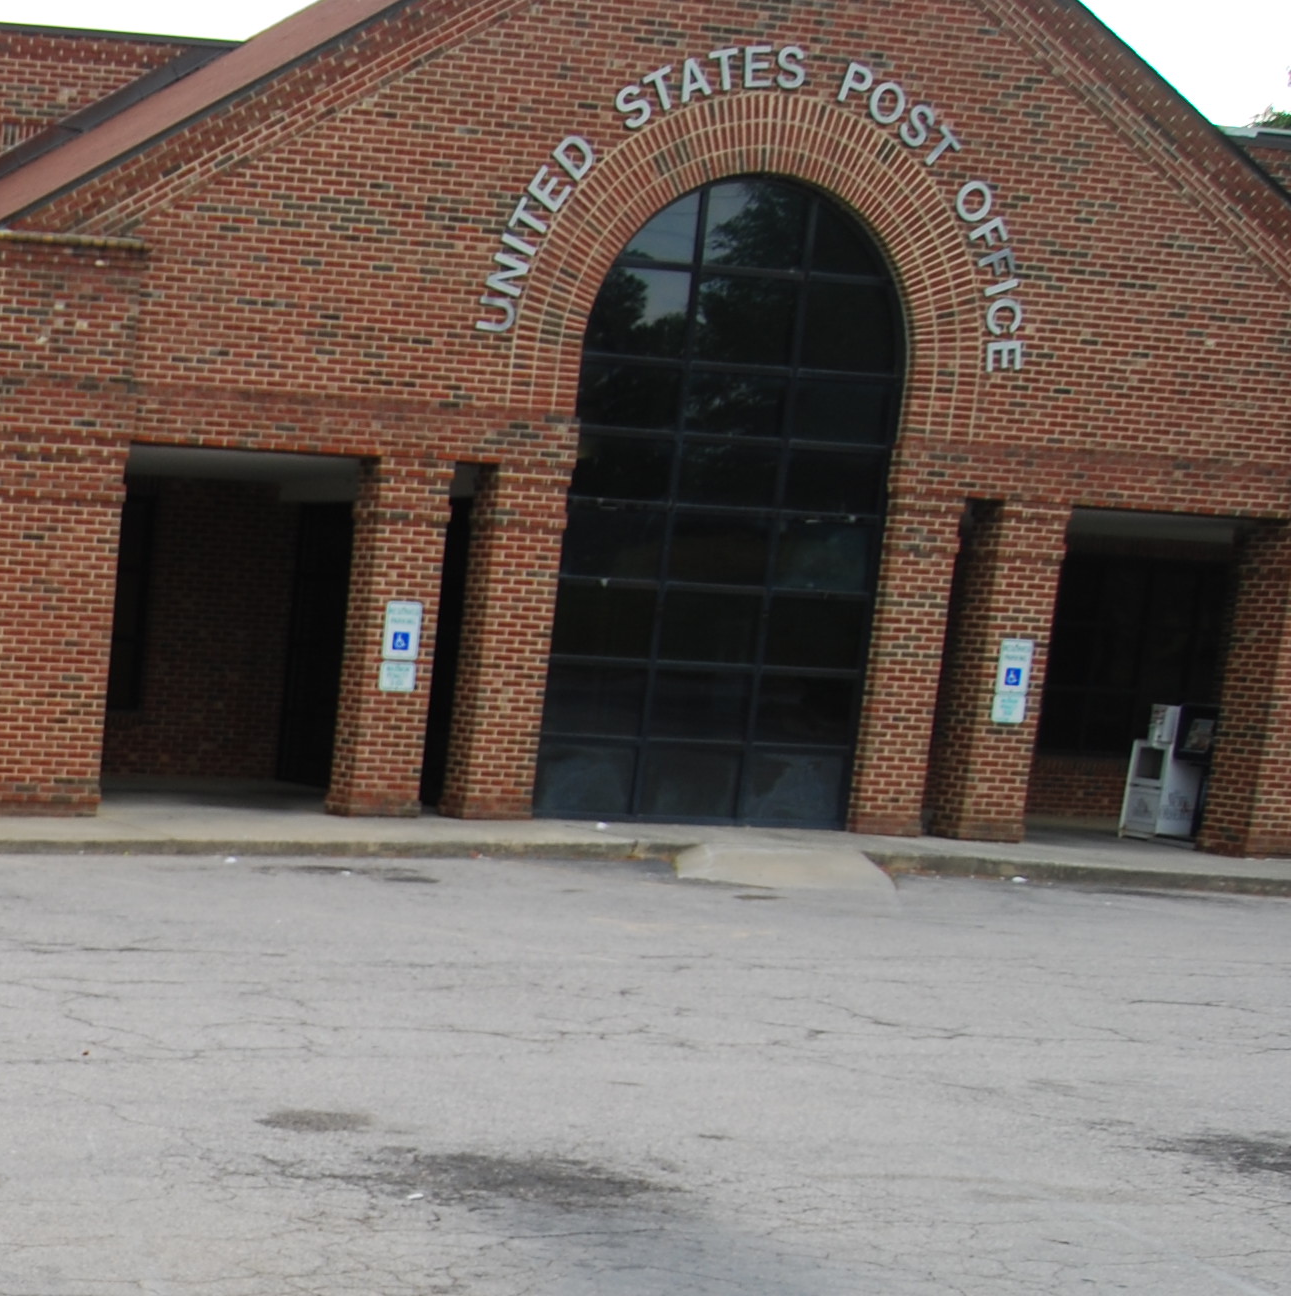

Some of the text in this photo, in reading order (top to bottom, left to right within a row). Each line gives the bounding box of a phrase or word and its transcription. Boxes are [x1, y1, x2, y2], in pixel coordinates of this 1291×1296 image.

[475, 45, 1022, 373] UNITED STATES POST OFFICE
